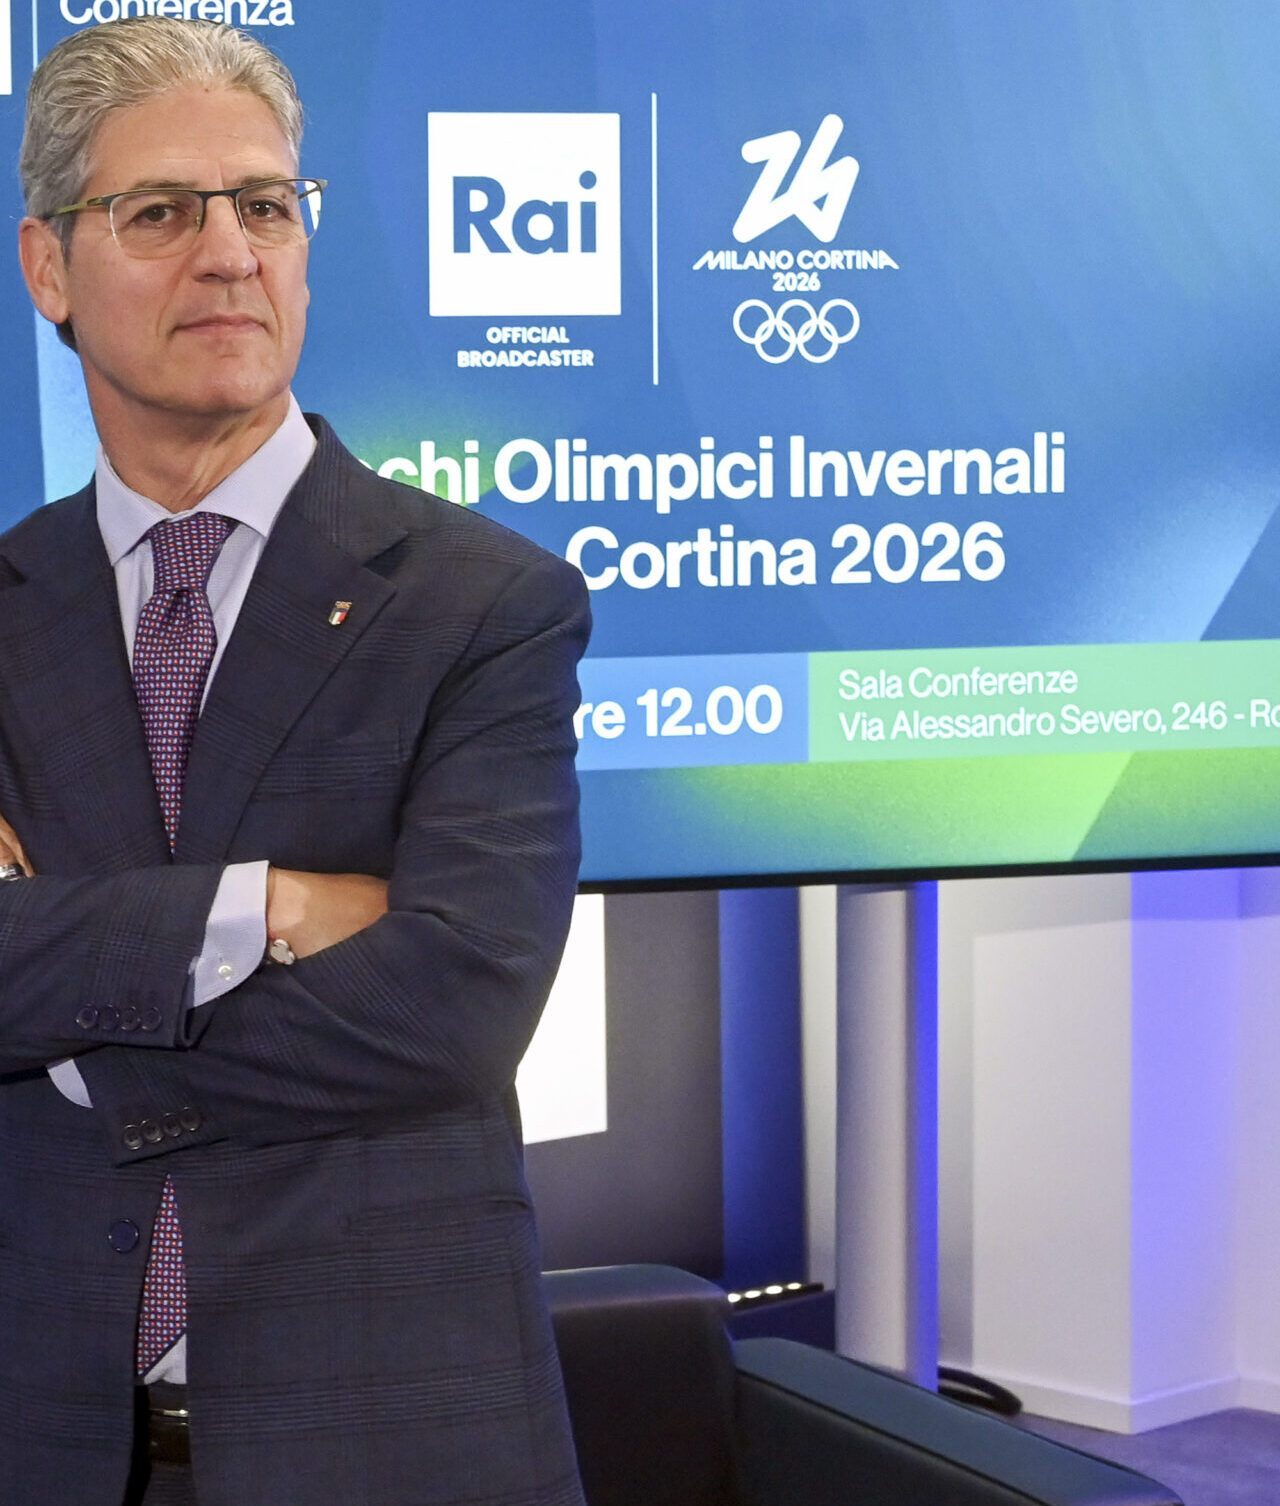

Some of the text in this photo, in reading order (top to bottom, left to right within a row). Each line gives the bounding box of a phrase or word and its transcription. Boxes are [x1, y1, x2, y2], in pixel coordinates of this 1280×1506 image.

[452, 170, 597, 255] Rai
[692, 249, 900, 271] MILANO CORTINA
[772, 271, 821, 292] 2026
[485, 325, 570, 344] OFFICIAL
[457, 349, 594, 368] BROADCASTER
[359, 431, 1065, 514] chi Olimpici Invernali
[565, 521, 1006, 591] Cortina 2026
[838, 666, 1079, 700] Sala Conferenze
[572, 684, 783, 739] re 12.00
[839, 710, 886, 742] Via
[890, 707, 1056, 740] Alessandro
[1060, 704, 1167, 735] Severo,
[1172, 700, 1228, 731] 246
